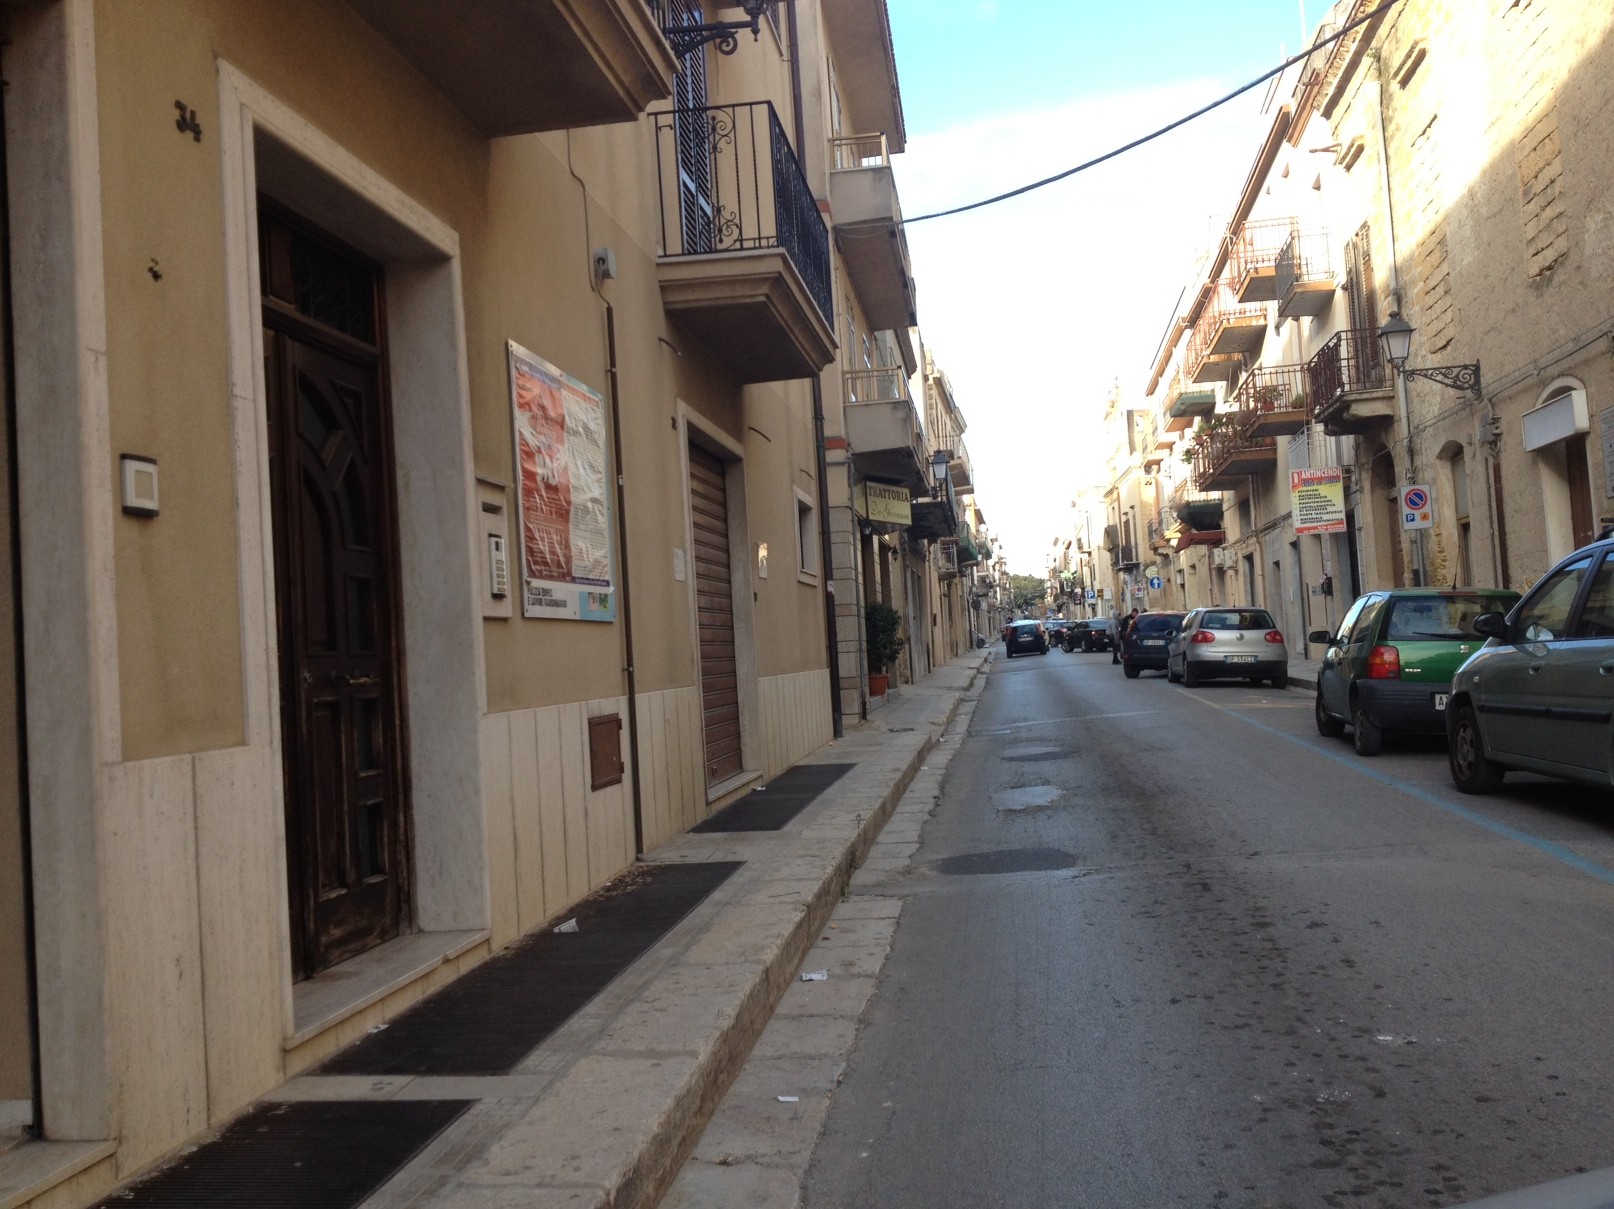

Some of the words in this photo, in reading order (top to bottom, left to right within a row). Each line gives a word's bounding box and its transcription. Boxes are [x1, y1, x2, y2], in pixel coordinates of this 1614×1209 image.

[174, 99, 203, 143] 34
[1302, 468, 1340, 478] ANTINCENDI
[868, 486, 909, 502] TRATTORIA
